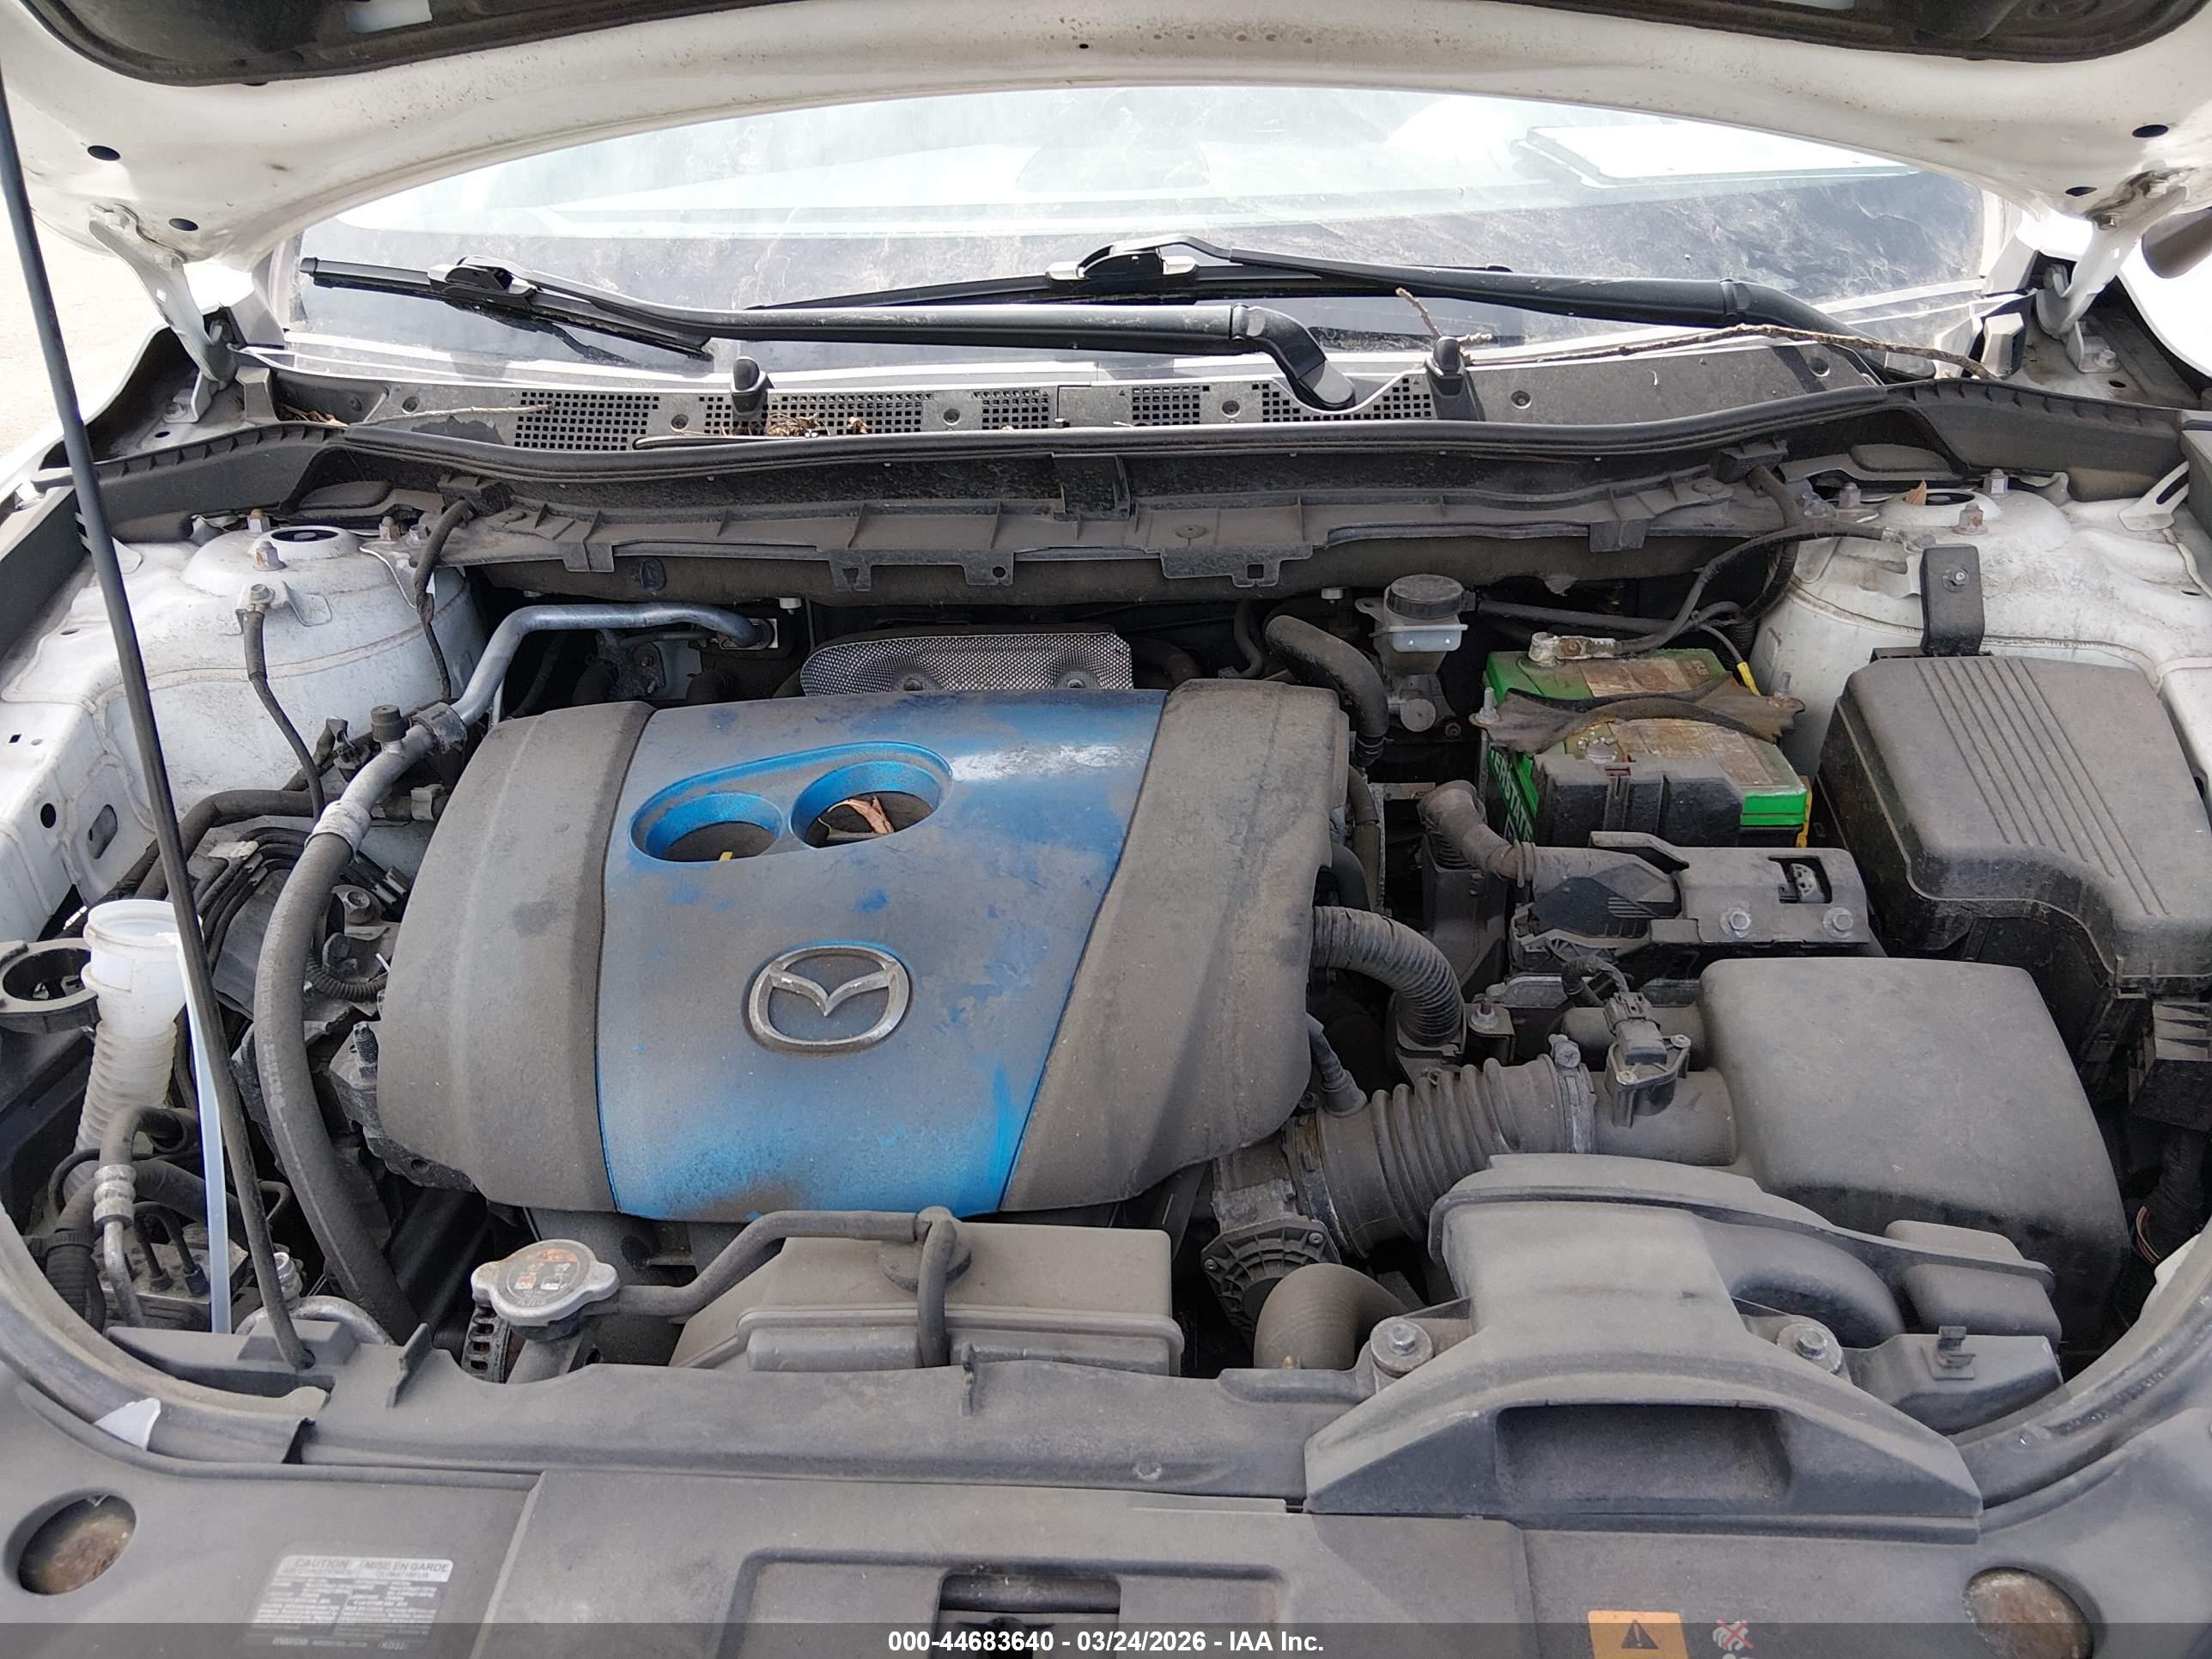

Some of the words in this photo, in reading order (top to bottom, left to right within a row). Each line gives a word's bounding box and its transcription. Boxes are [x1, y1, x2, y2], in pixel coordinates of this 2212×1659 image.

[295, 1558, 349, 1568] CAUTION
[392, 1561, 409, 1571] EN
[410, 1561, 448, 1572] GARDE
